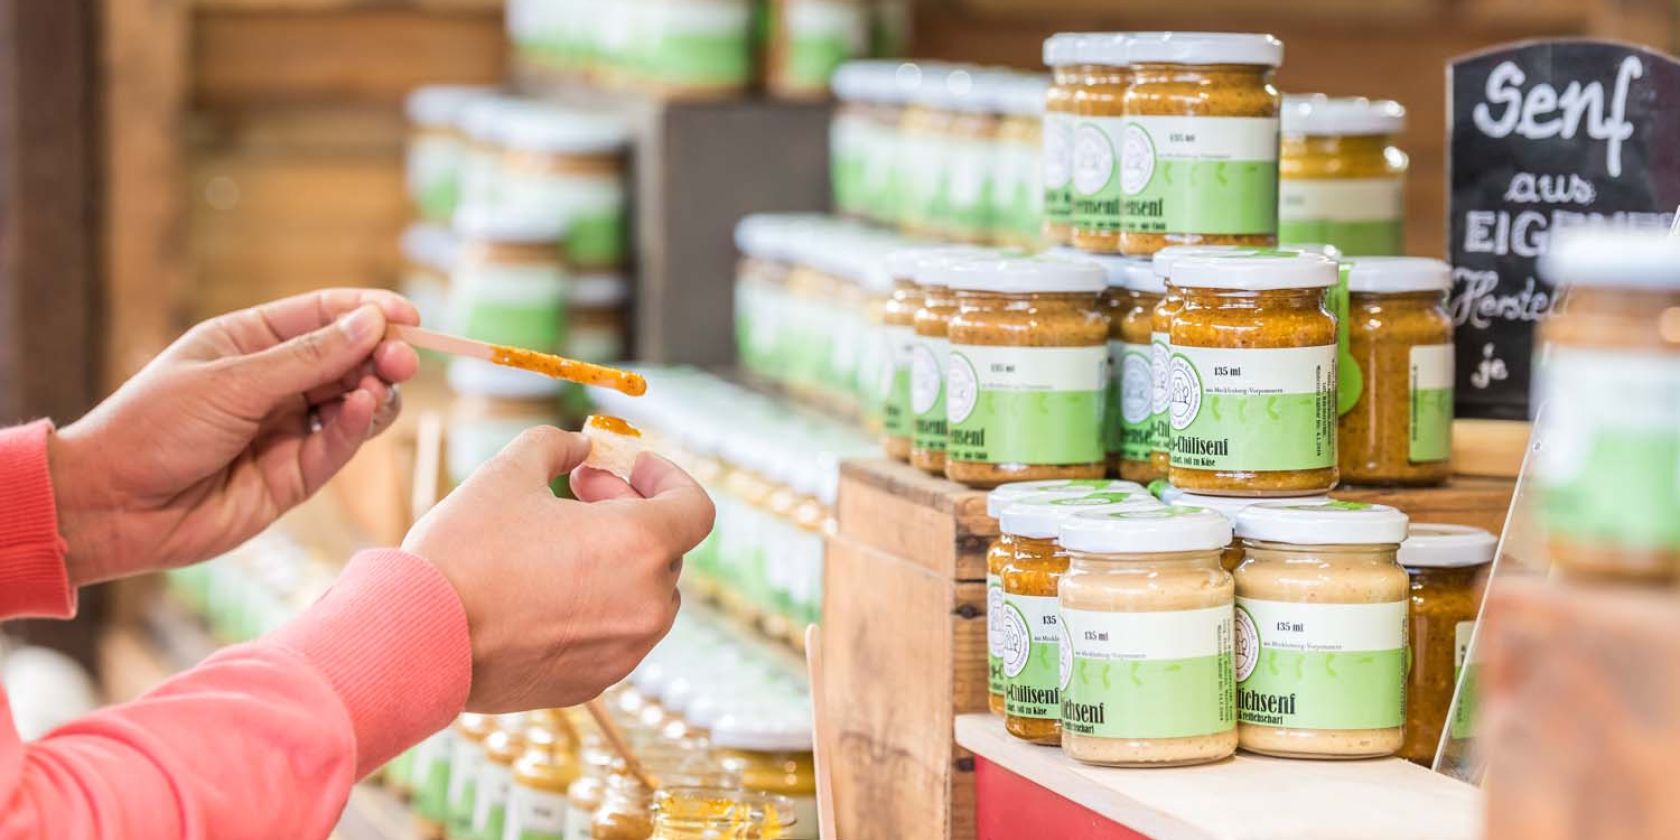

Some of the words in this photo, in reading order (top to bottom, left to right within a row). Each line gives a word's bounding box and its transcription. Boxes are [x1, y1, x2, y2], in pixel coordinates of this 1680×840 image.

[1473, 56, 1643, 178] Senf
[1504, 171, 1597, 204] aus
[1214, 367, 1228, 376] 135
[1230, 367, 1241, 376] ml
[1471, 342, 1509, 389] je
[1042, 615, 1057, 625] 135
[1276, 622, 1290, 632] 135
[1292, 623, 1304, 632] ml
